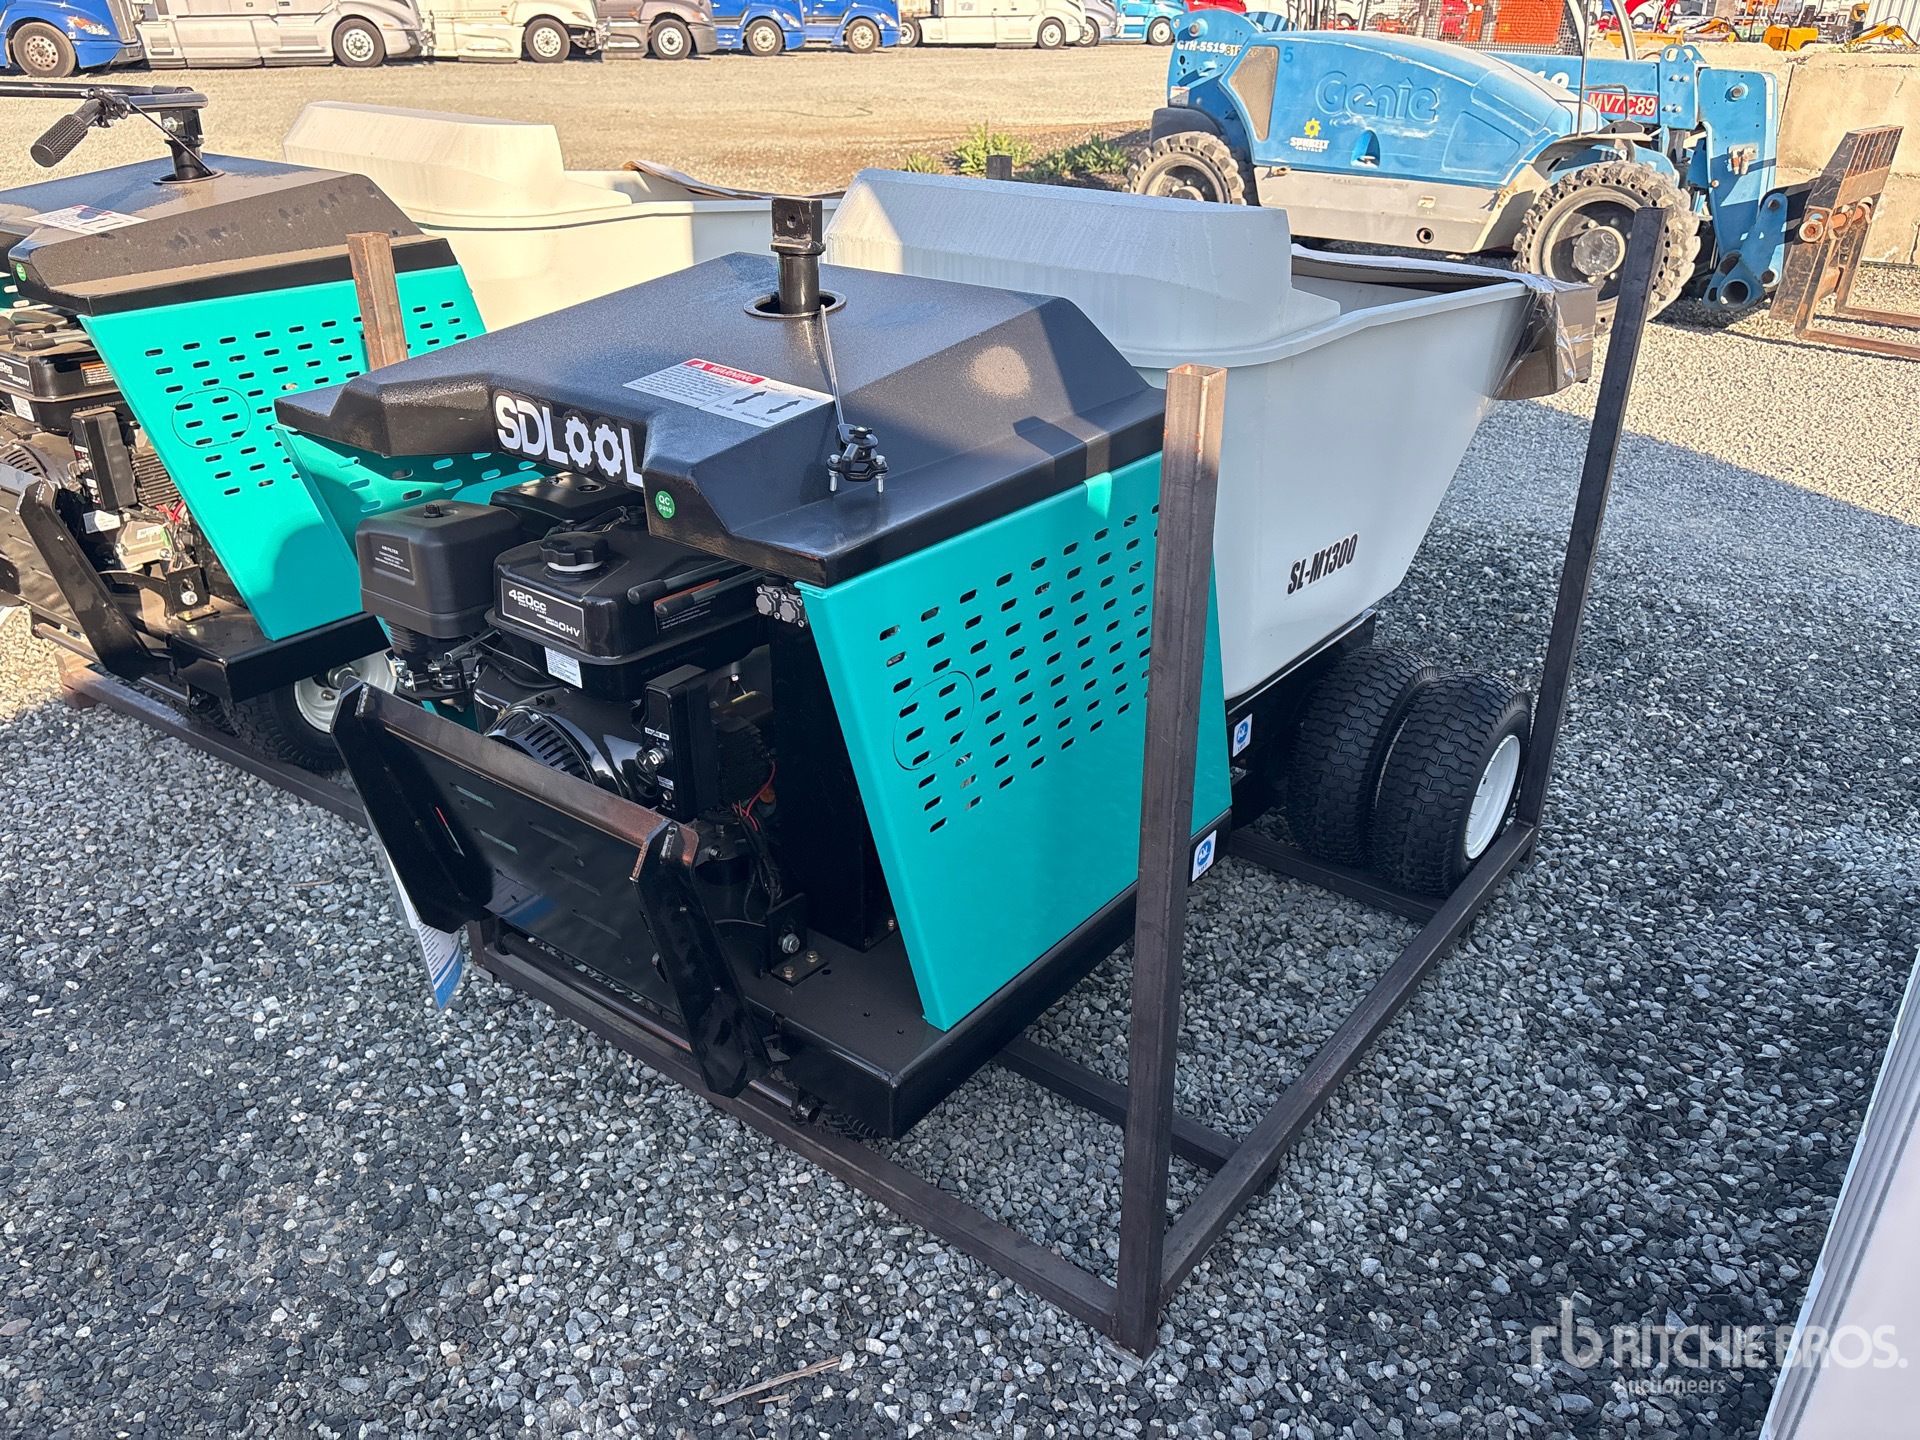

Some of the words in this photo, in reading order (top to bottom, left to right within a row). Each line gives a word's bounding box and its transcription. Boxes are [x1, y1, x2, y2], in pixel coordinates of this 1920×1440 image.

[1176, 39, 1227, 53] GTH-5519
[1283, 46, 1294, 63] 5
[1315, 70, 1440, 123] Genie
[709, 365, 757, 382] WARNING
[658, 494, 671, 506] QC
[1287, 533, 1358, 595] SL-M1300
[508, 588, 547, 612] 420cc
[558, 621, 580, 637] OHV
